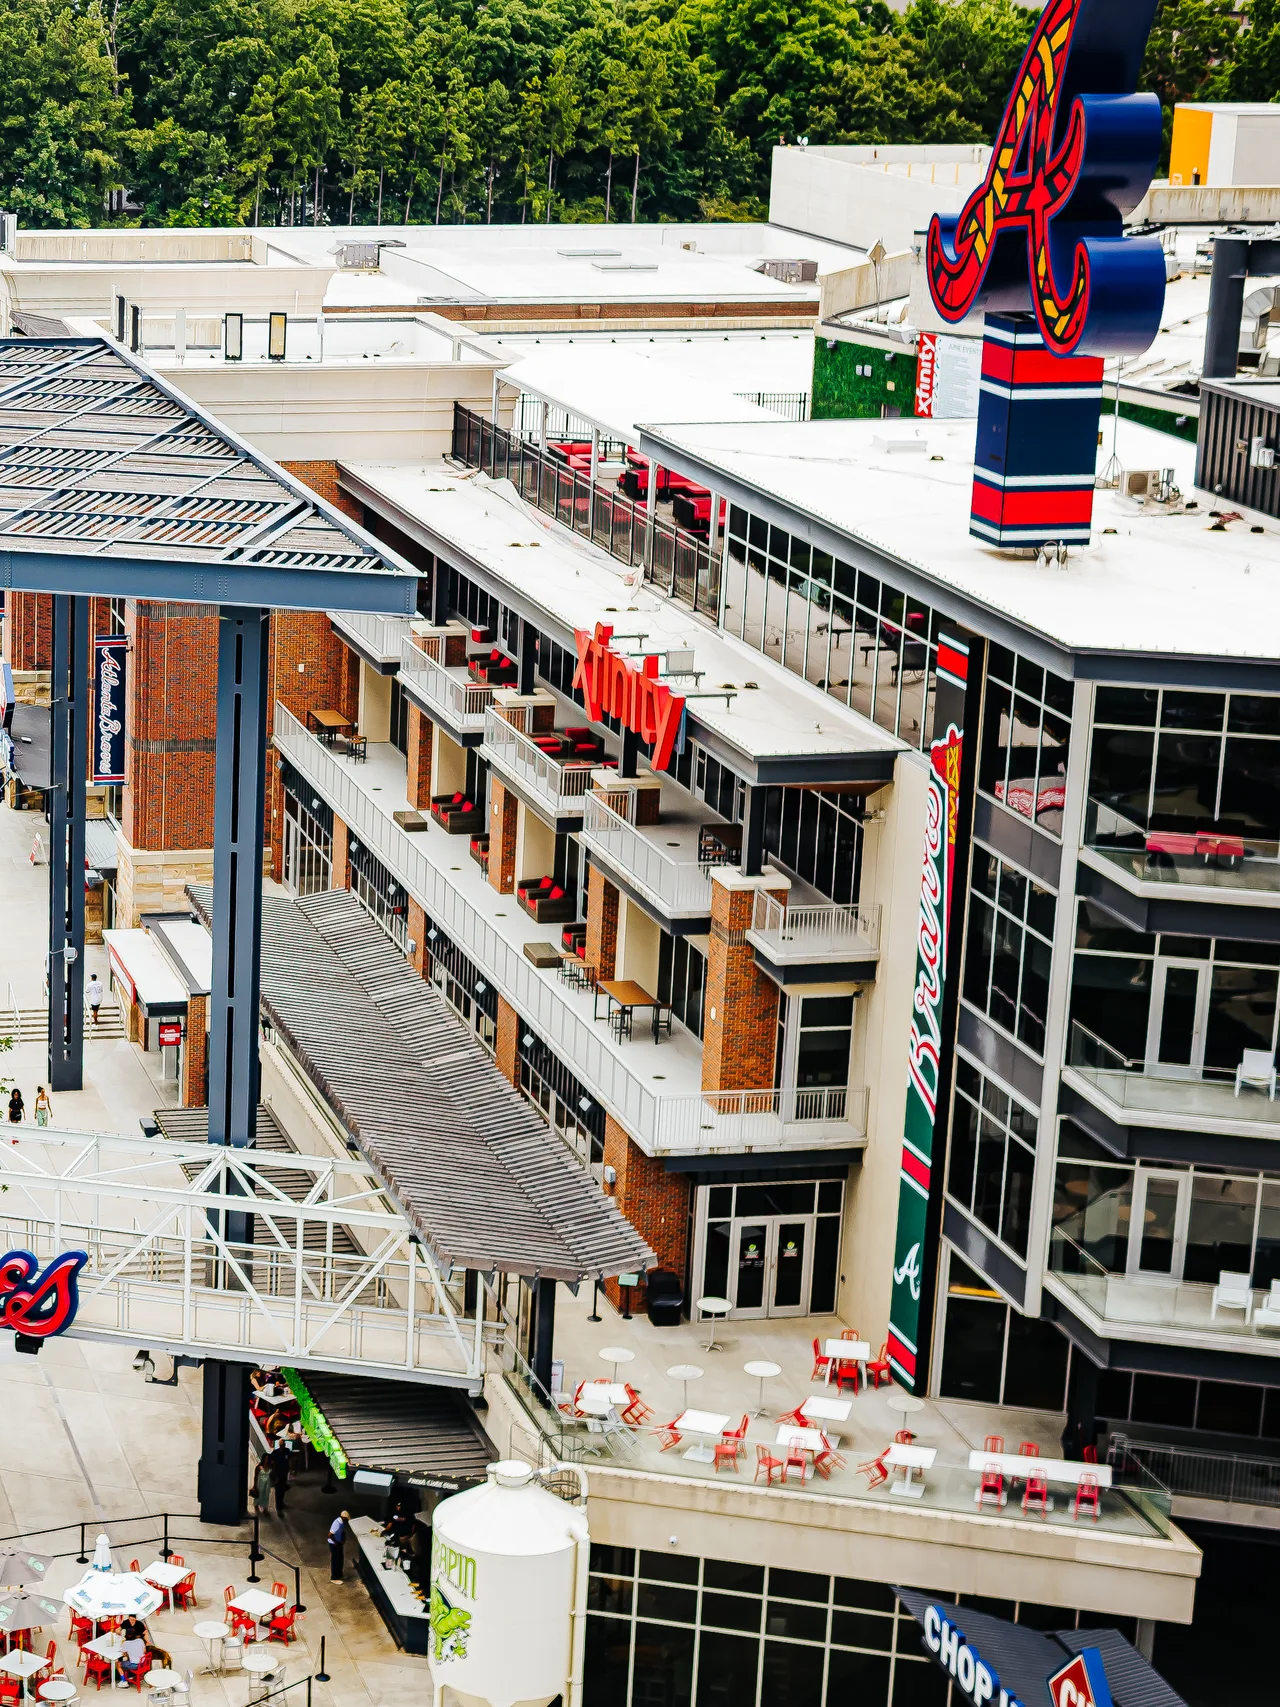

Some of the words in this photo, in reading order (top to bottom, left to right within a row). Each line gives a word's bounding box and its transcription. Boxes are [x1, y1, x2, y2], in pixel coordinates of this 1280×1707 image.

[917, 334, 936, 416] xfinity
[100, 647, 121, 716] Atlanta
[572, 622, 686, 771] xfinity
[99, 714, 122, 774] Braves
[893, 1242, 920, 1300] A
[923, 1605, 1000, 1707] CHOP
